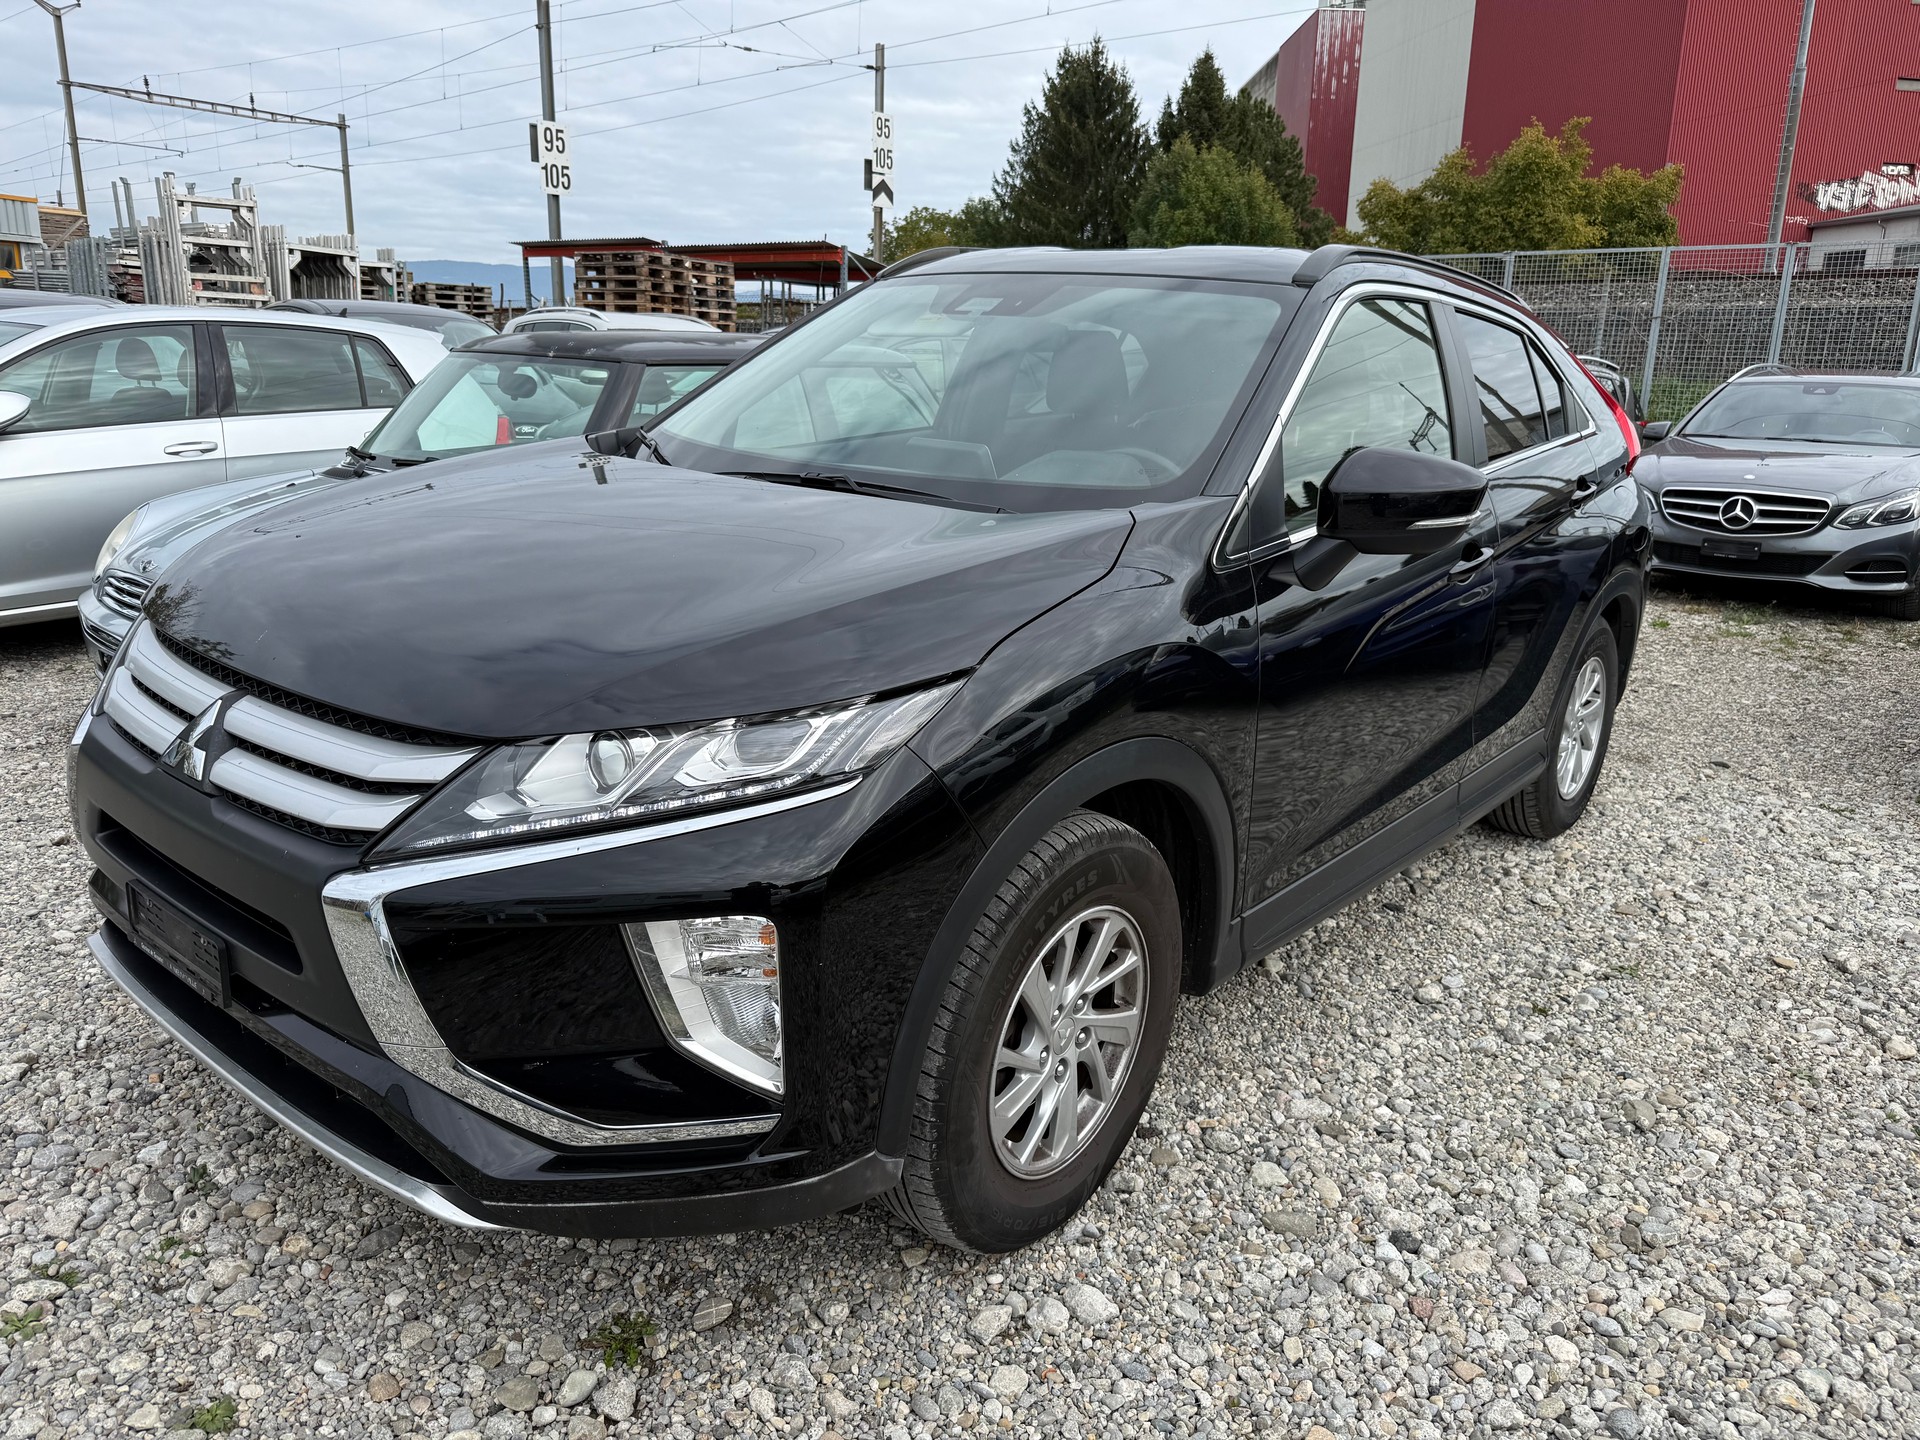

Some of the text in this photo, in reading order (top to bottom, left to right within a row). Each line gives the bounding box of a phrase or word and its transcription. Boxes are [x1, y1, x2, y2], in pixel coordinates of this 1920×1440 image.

[543, 126, 566, 154] 95
[876, 116, 891, 139] 95
[873, 146, 893, 170] 105
[541, 162, 571, 190] 105
[1034, 869, 1098, 934] TYRES
